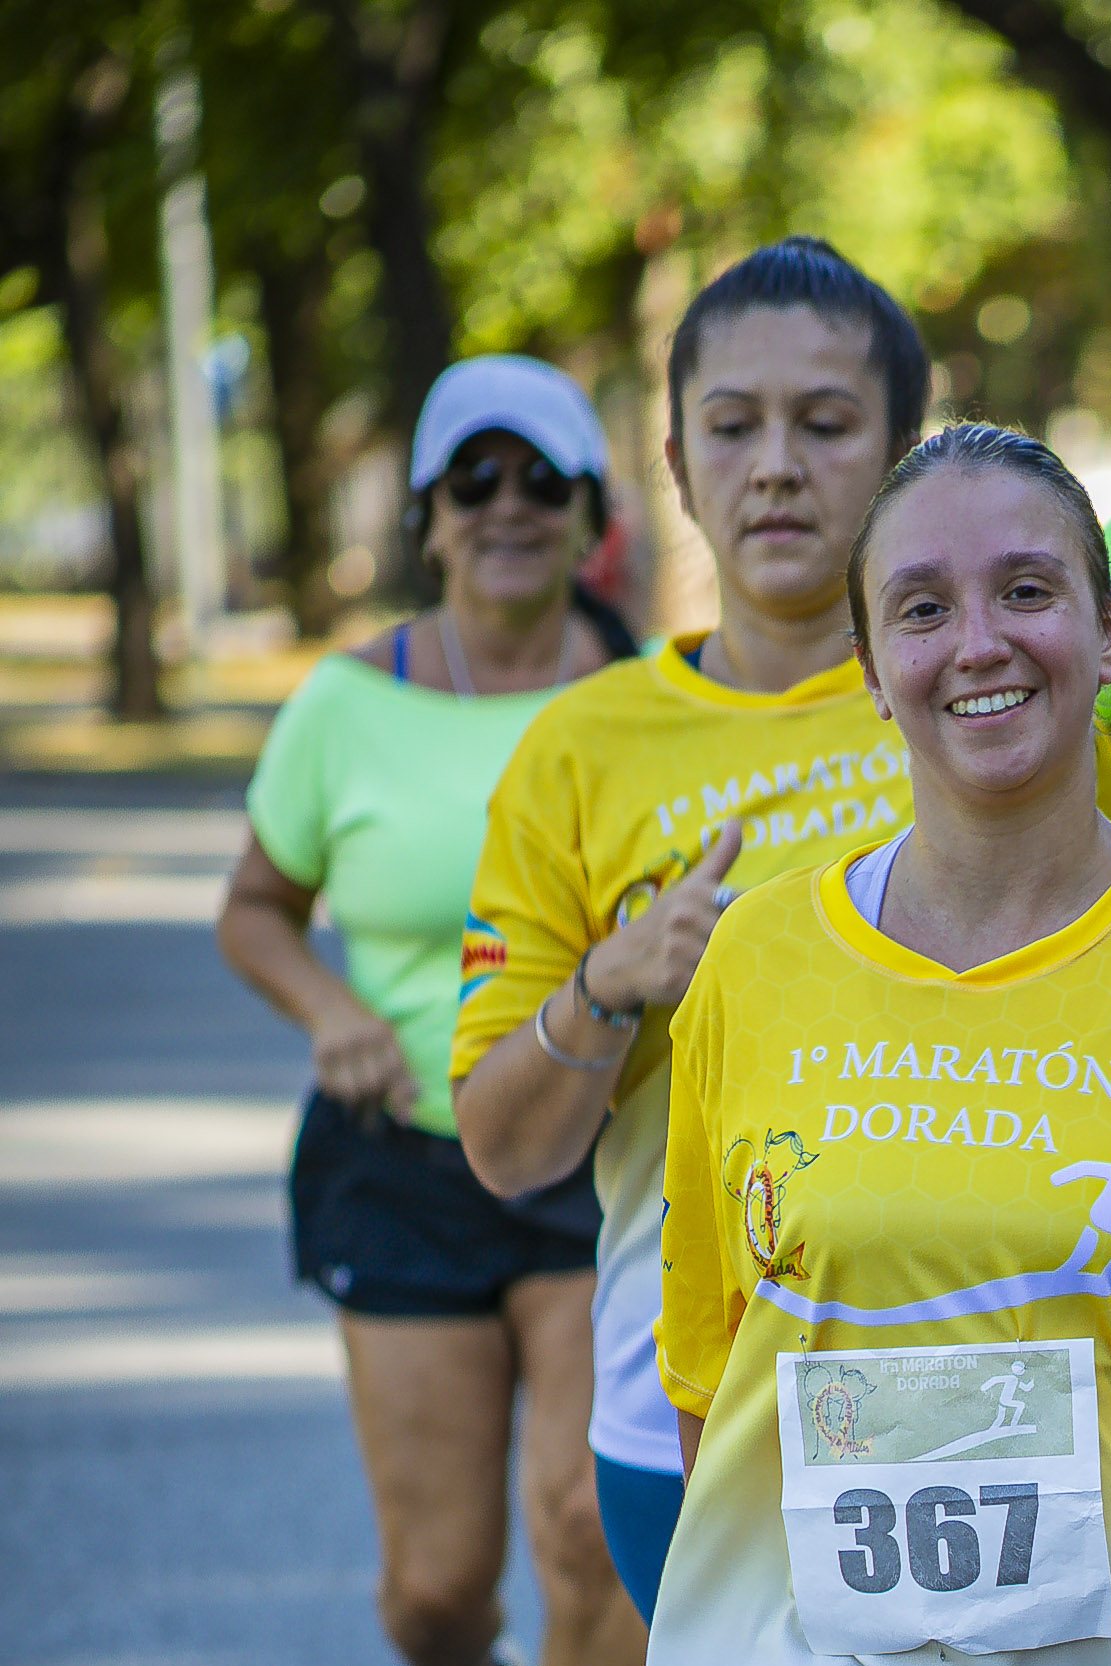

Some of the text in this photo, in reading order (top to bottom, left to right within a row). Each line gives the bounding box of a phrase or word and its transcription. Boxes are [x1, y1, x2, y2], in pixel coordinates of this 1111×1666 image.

[701, 742, 911, 818] MARATÓ
[819, 1103, 1058, 1153] DORADA
[897, 1374, 961, 1392] DORADA
[833, 1482, 1039, 1593] 367
